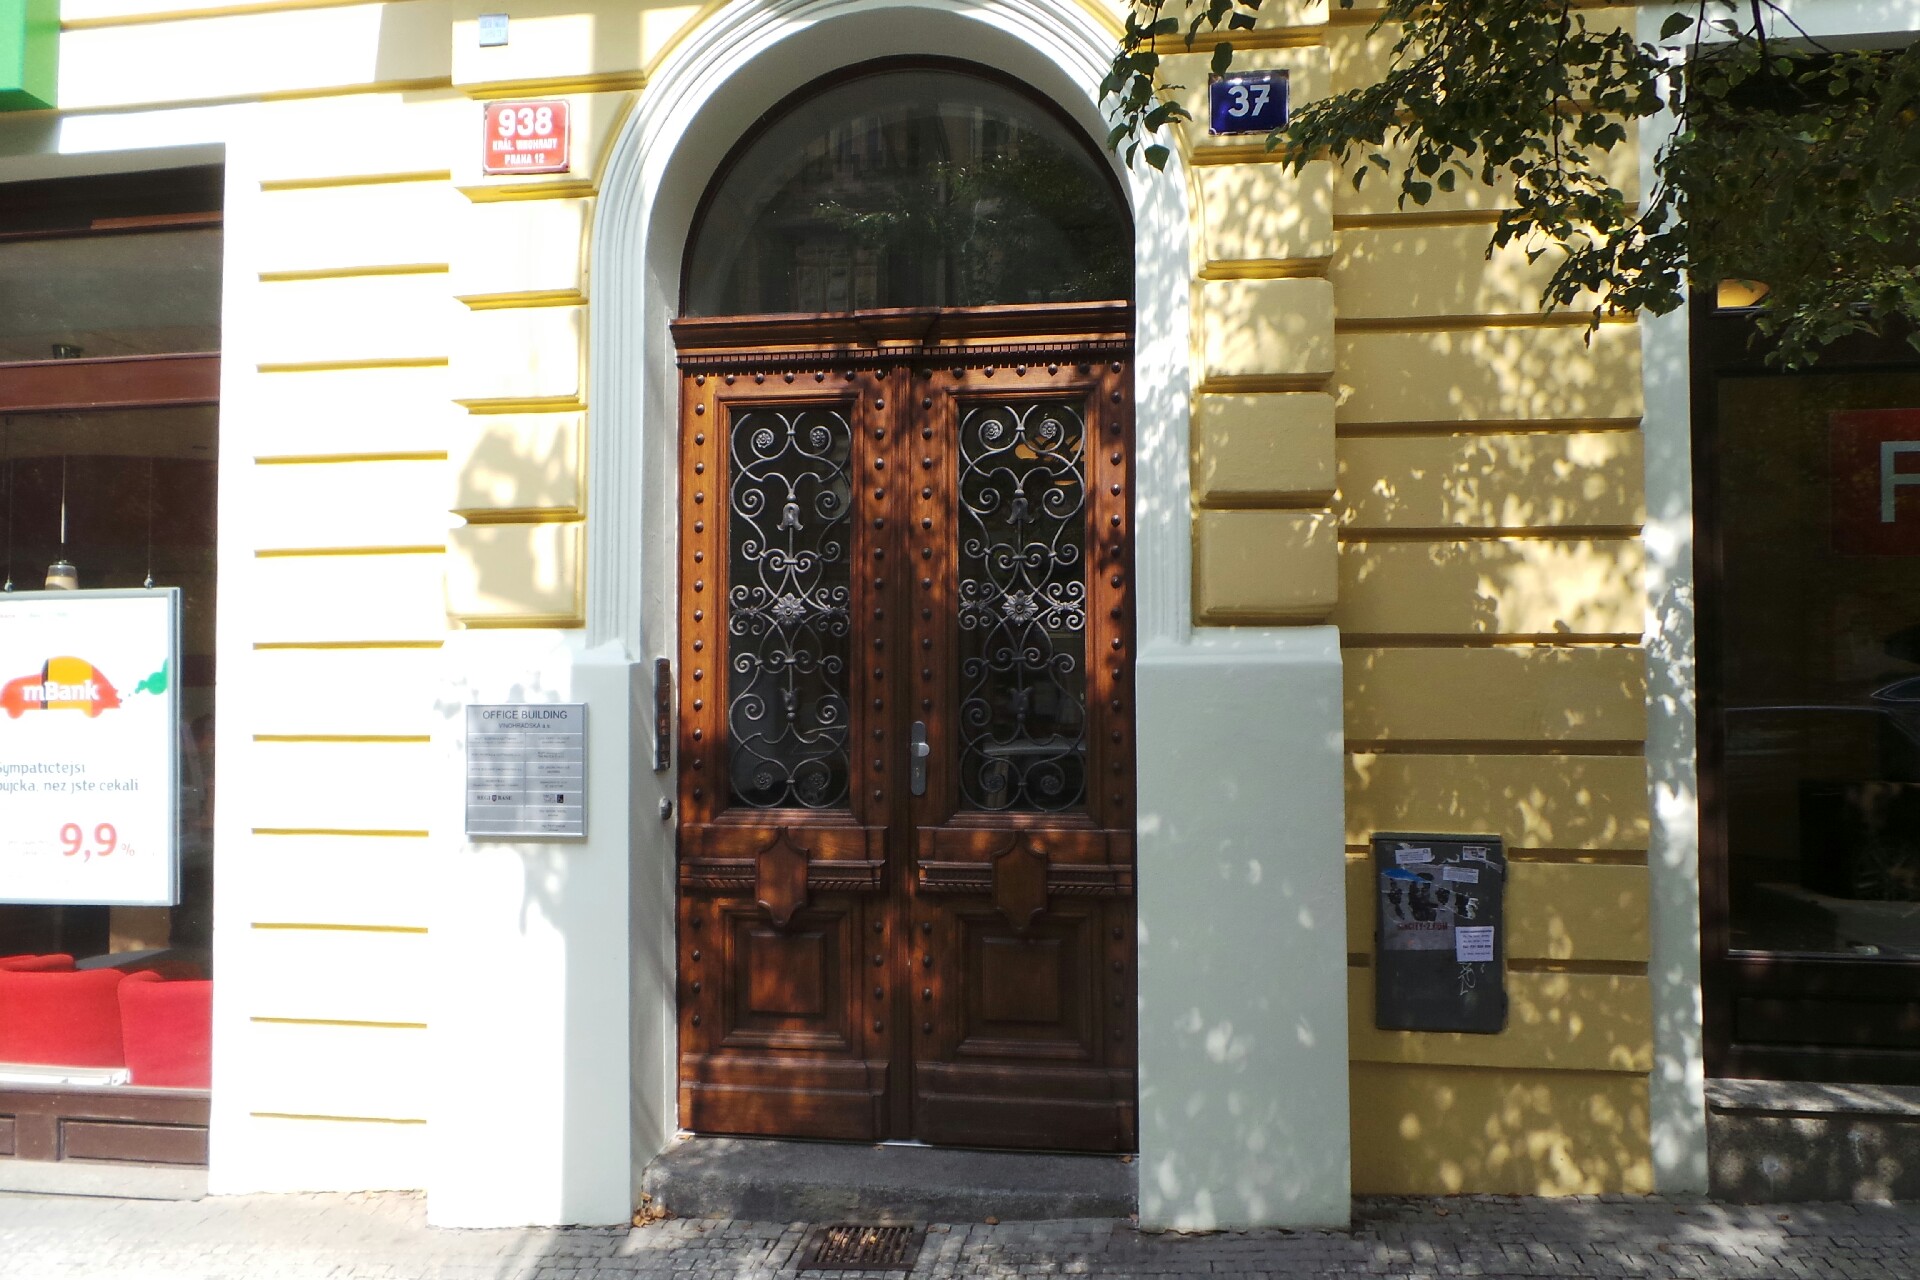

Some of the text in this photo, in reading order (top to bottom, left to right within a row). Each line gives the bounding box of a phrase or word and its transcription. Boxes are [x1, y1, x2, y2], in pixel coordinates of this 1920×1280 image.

[1228, 84, 1271, 117] 37
[498, 106, 553, 137] 938
[504, 152, 545, 165] PRAHA 12
[23, 680, 100, 702] mBank
[482, 710, 568, 720] OFFICE BUILDING
[71, 780, 96, 795] jste
[59, 822, 118, 863] 9,9
